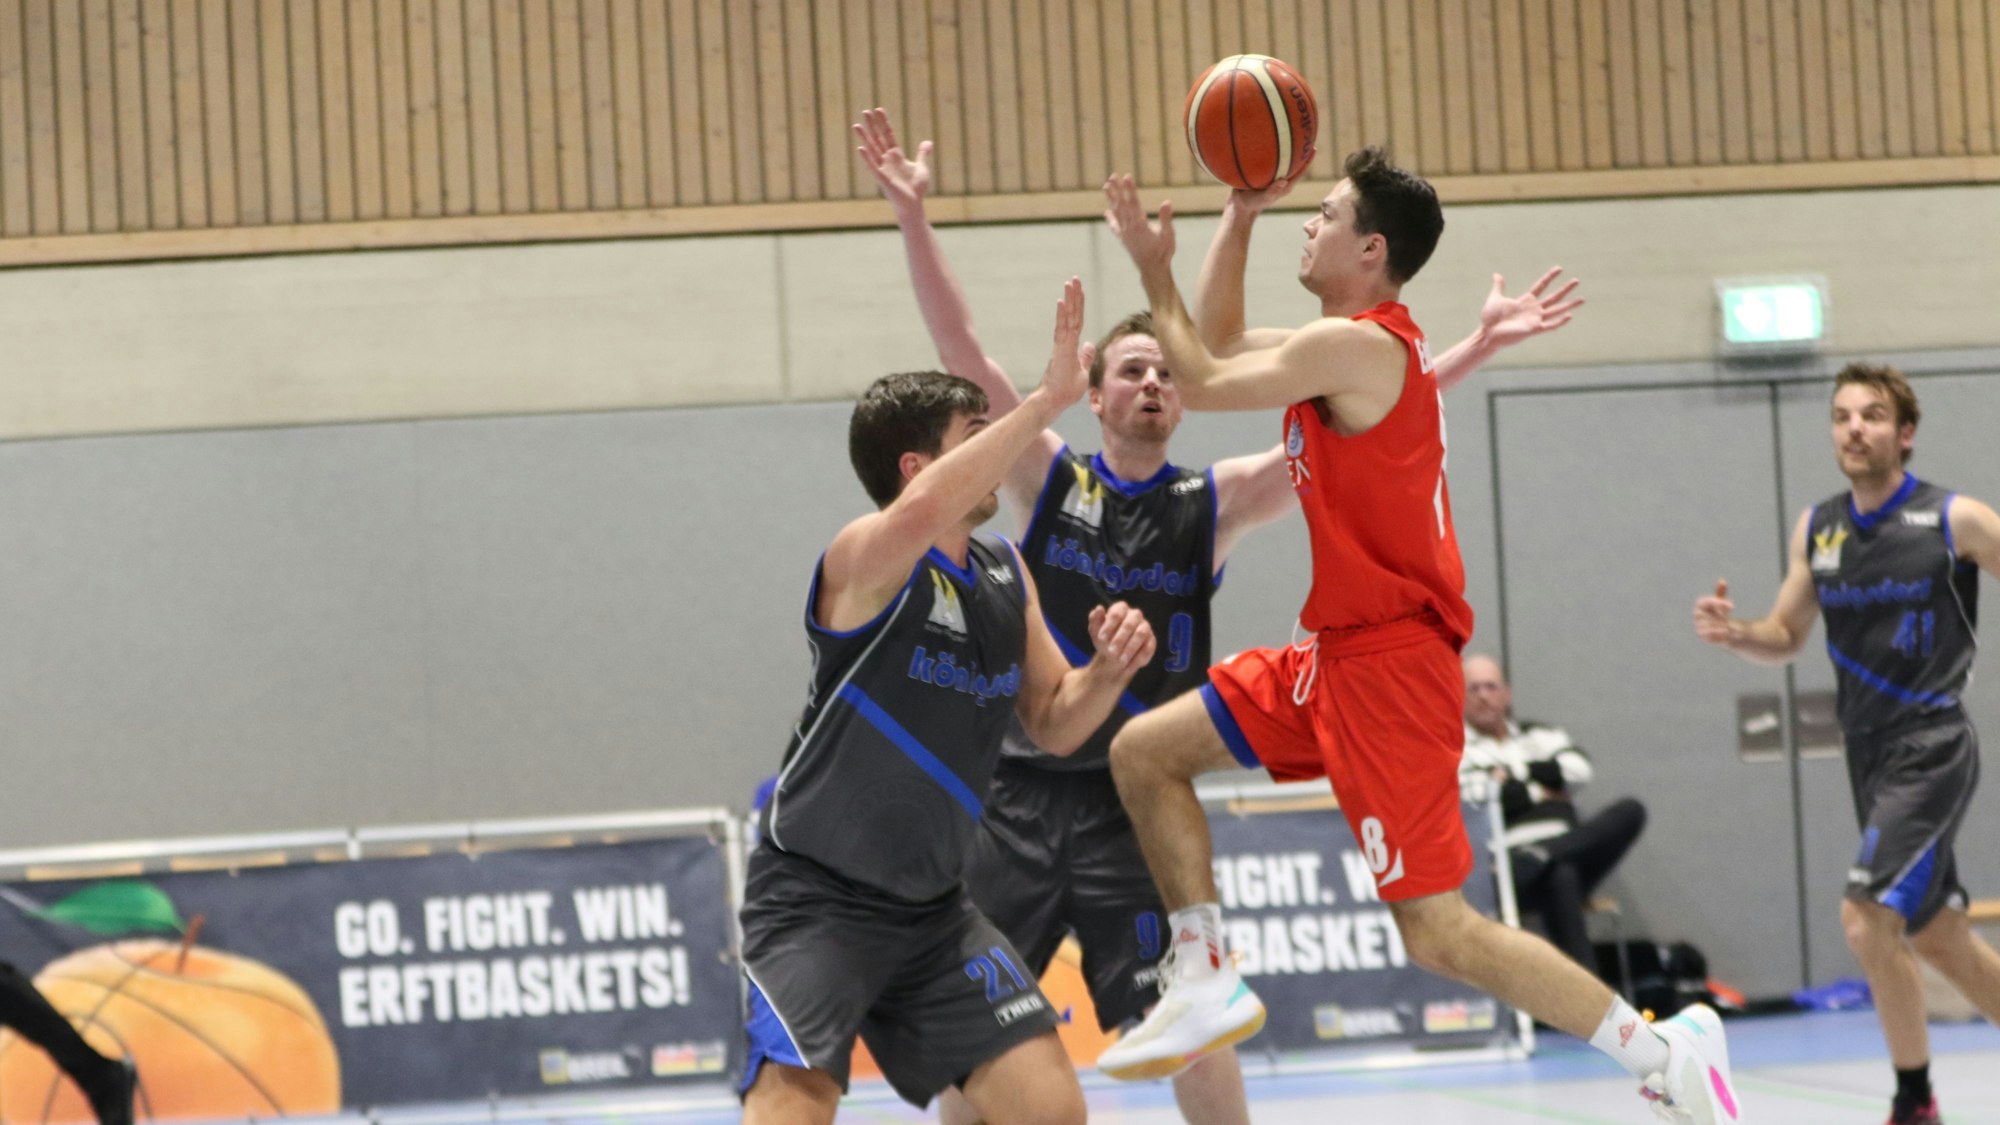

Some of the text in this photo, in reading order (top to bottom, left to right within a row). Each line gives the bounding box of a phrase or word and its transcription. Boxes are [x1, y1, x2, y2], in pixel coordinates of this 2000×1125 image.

[1165, 612, 1193, 673] 9
[1892, 610, 1934, 658] 41
[1361, 815, 1389, 874] 8
[335, 884, 684, 958] GO. FIGHT. WIN.
[1136, 911, 1160, 960] 9
[338, 946, 691, 1028] ERFTBASKETS!
[964, 946, 1028, 1003] 21
